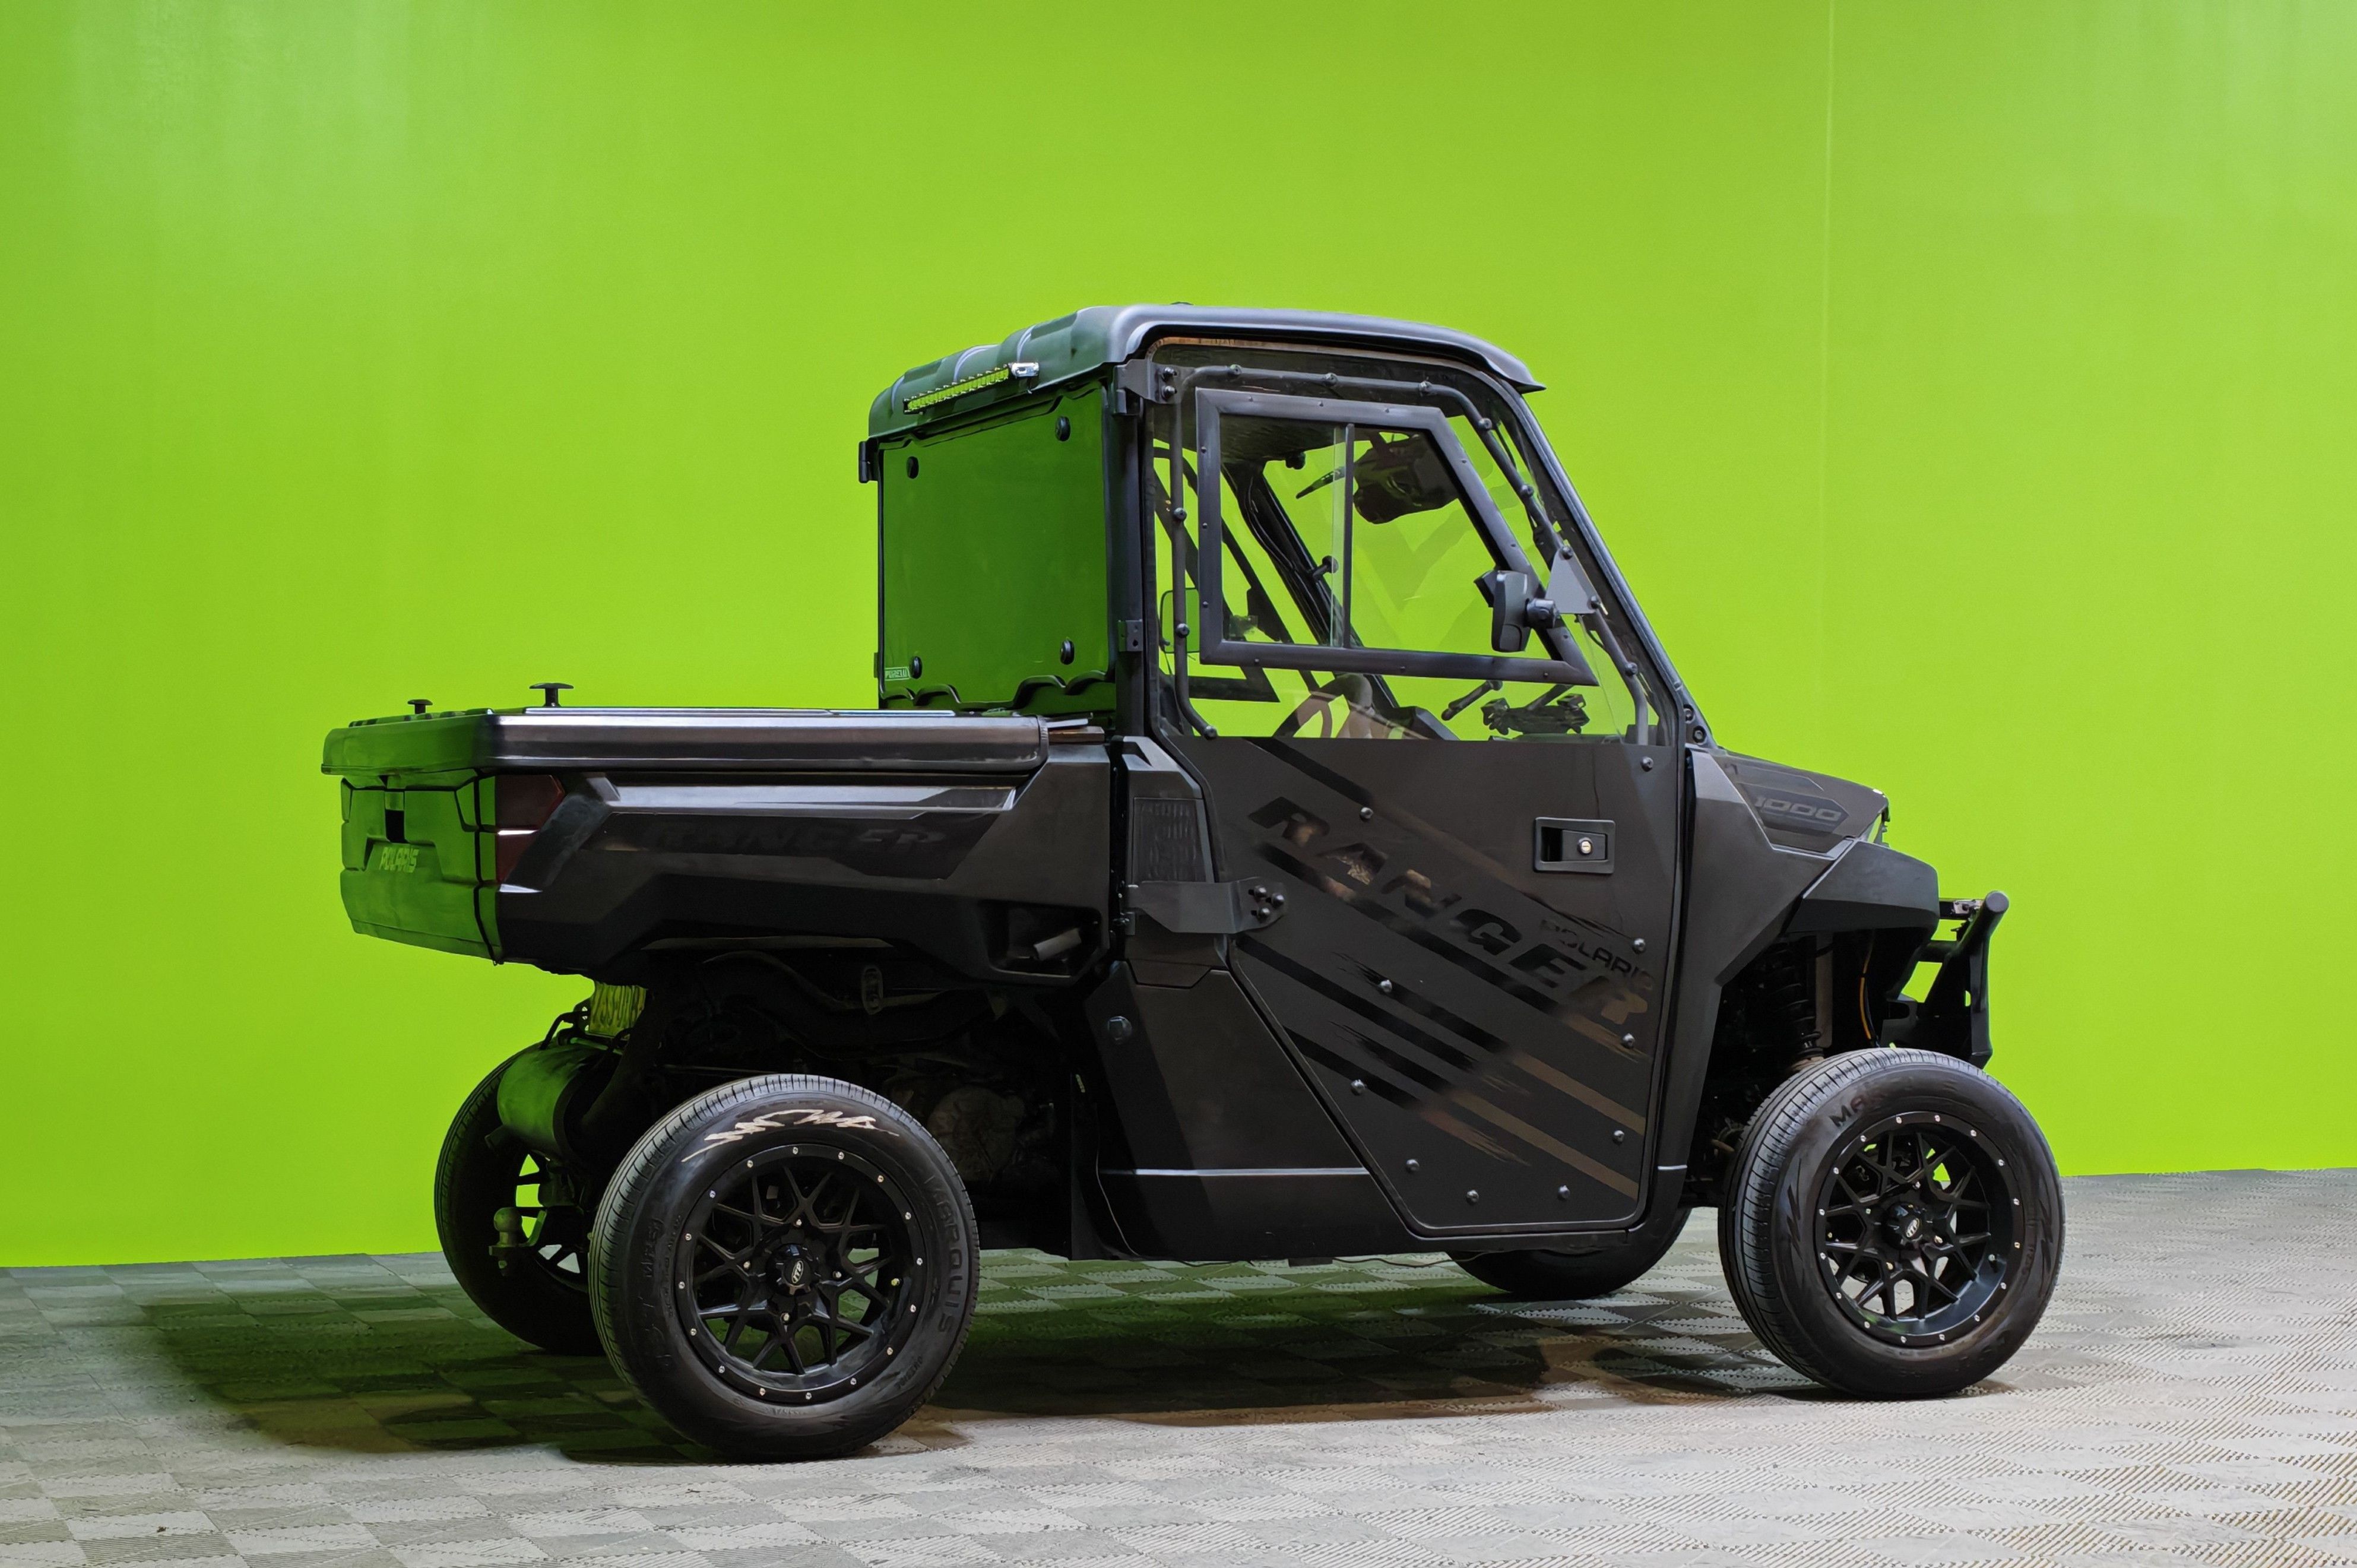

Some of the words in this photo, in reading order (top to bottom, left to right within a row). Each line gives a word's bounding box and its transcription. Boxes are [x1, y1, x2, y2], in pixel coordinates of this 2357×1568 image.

[1754, 796, 1842, 821] 1000
[379, 846, 419, 873] POLARIS
[1247, 796, 1648, 1025] RANGER
